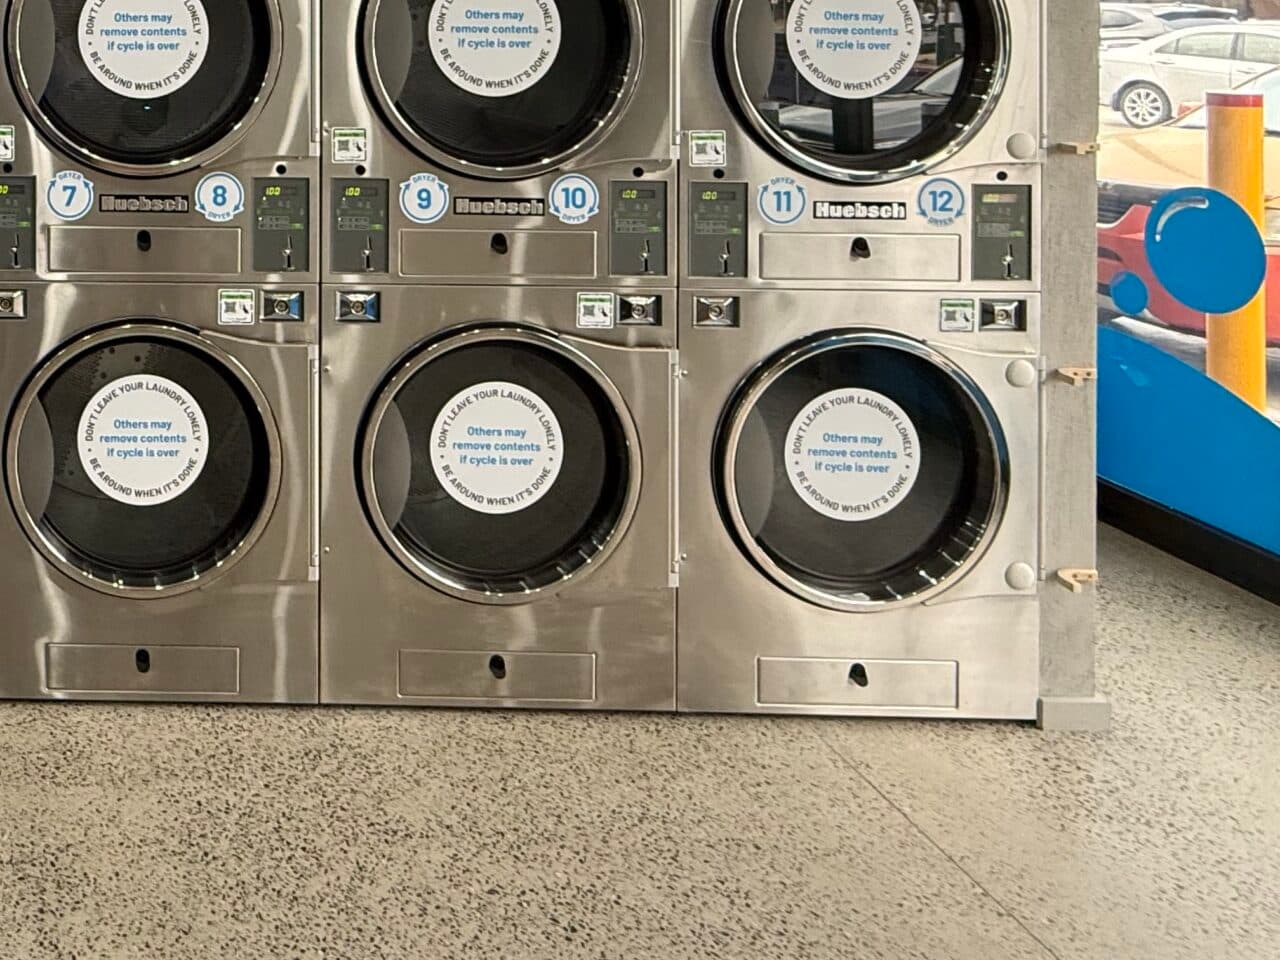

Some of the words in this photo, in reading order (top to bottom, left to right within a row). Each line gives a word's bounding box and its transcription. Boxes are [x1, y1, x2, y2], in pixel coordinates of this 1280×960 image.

[86, 7, 98, 35] DON'T
[184, 0, 201, 34] LONELY
[114, 13, 148, 22] Others
[151, 14, 172, 24] may
[465, 10, 500, 19] Others
[503, 12, 524, 21] may
[824, 11, 860, 21] Others
[862, 14, 884, 23] may
[141, 28, 187, 36] contents
[492, 25, 539, 34] contents
[851, 27, 899, 35] contents
[108, 41, 115, 50] if
[117, 42, 144, 52] cycle
[146, 42, 155, 50] is
[458, 38, 466, 47] if
[468, 39, 495, 49] cycle
[497, 39, 506, 48] is
[817, 40, 824, 48] if
[826, 40, 854, 51] cycle
[856, 41, 865, 50] is
[90, 51, 101, 64] BE
[98, 64, 132, 88] AROUND
[135, 80, 162, 90] WHEN
[164, 72, 180, 86] IT'S
[179, 51, 197, 74] DONE
[412, 175, 437, 184] DRYER
[770, 175, 796, 186] DRYER
[62, 186, 77, 207] 7
[212, 185, 227, 206] 8
[417, 188, 432, 209] 9
[562, 187, 587, 209] 10
[772, 191, 792, 211] 11
[100, 196, 188, 211] Huebsch
[455, 198, 544, 214] Huebsch
[929, 191, 954, 212] 12
[816, 202, 905, 218] Huebsch
[114, 420, 148, 429] Others
[151, 421, 172, 430] may
[438, 420, 451, 448] DON'T
[449, 396, 472, 421] LEAVE
[473, 389, 498, 401] YOUR
[501, 391, 541, 414] LAUNDRY
[539, 415, 556, 450] LONELY
[467, 427, 502, 436] Others
[505, 429, 526, 439] may
[140, 435, 186, 443] contents
[823, 433, 858, 443] Others
[861, 436, 882, 446] may
[494, 443, 541, 451] contents
[107, 448, 114, 457] if
[117, 448, 143, 459] cycle
[146, 448, 154, 457] is
[850, 450, 897, 458] contents
[460, 455, 467, 464] if
[470, 456, 496, 466] cycle
[499, 456, 508, 465] is
[815, 462, 822, 470] if
[825, 463, 852, 473] cycle
[855, 463, 864, 472] is
[442, 464, 453, 477] BE
[449, 477, 484, 502] AROUND
[487, 496, 514, 505] WHEN
[516, 488, 532, 502] IT'S
[532, 467, 550, 490] DONE
